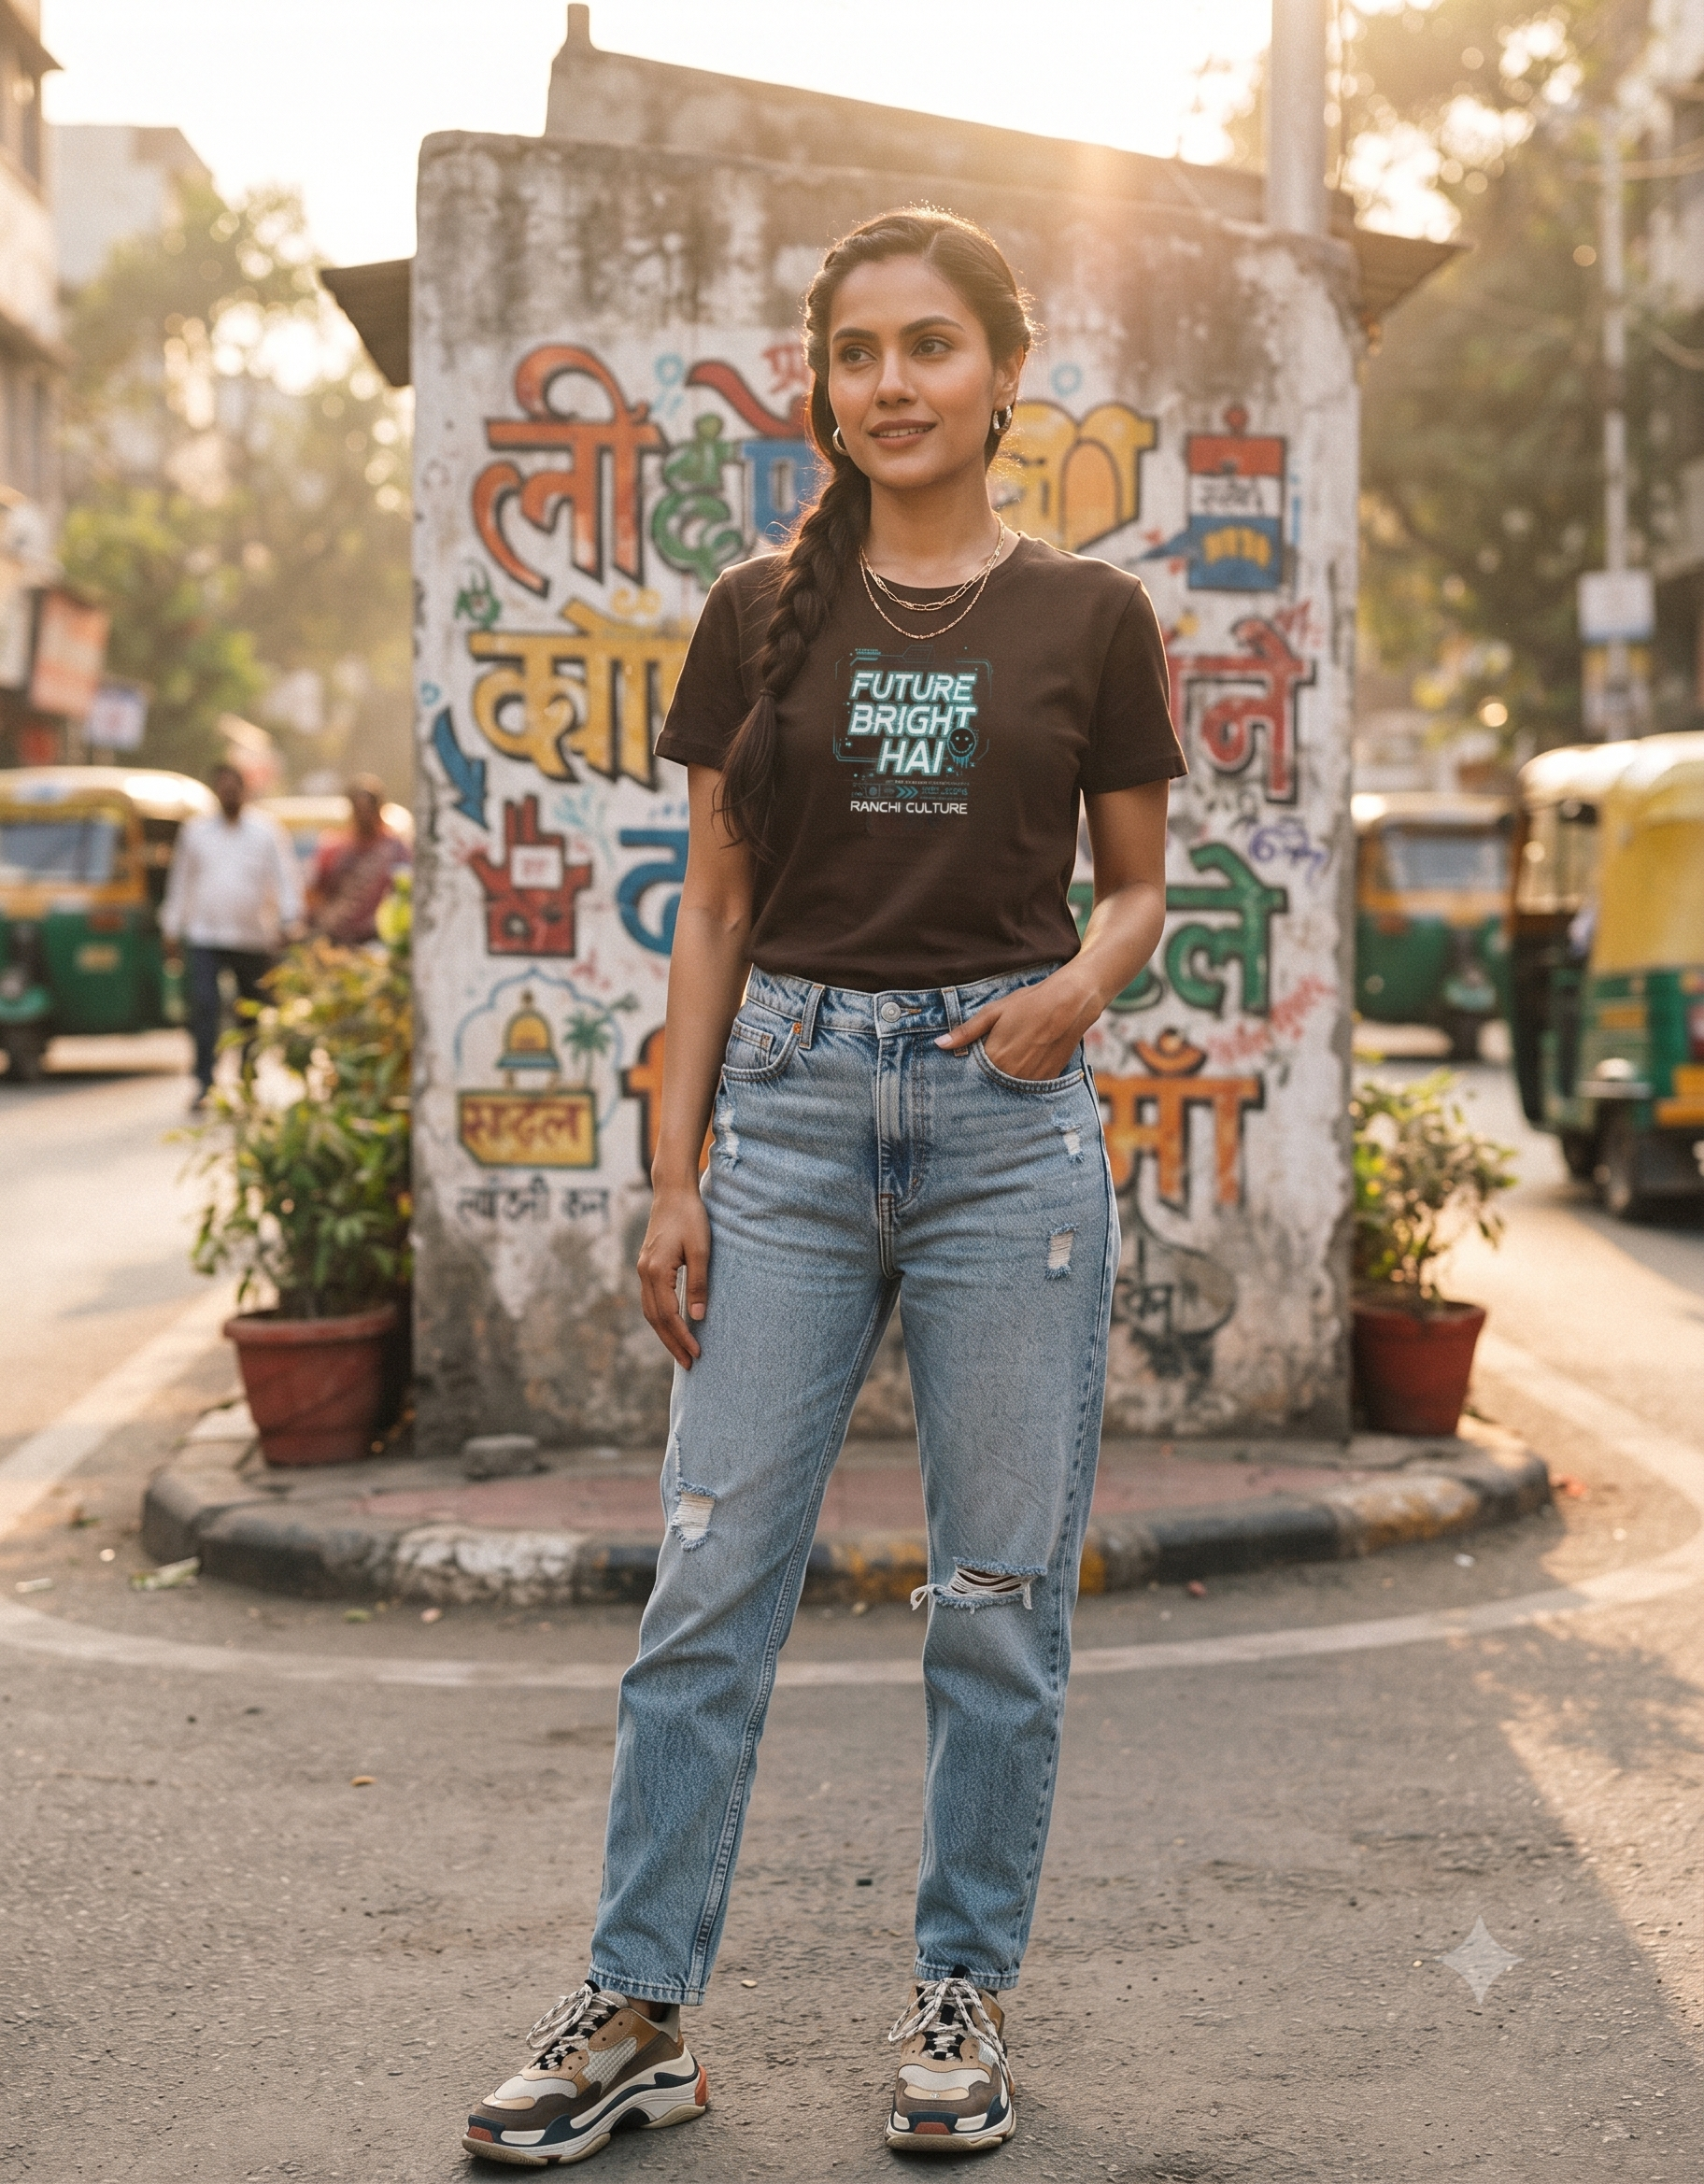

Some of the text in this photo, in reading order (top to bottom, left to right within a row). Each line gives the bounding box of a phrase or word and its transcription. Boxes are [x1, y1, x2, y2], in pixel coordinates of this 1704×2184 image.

[849, 671, 977, 702] FUTURE
[848, 703, 977, 736] BRIGHT
[877, 739, 946, 774] HAI
[850, 801, 968, 815] RANCHI CULTURE
